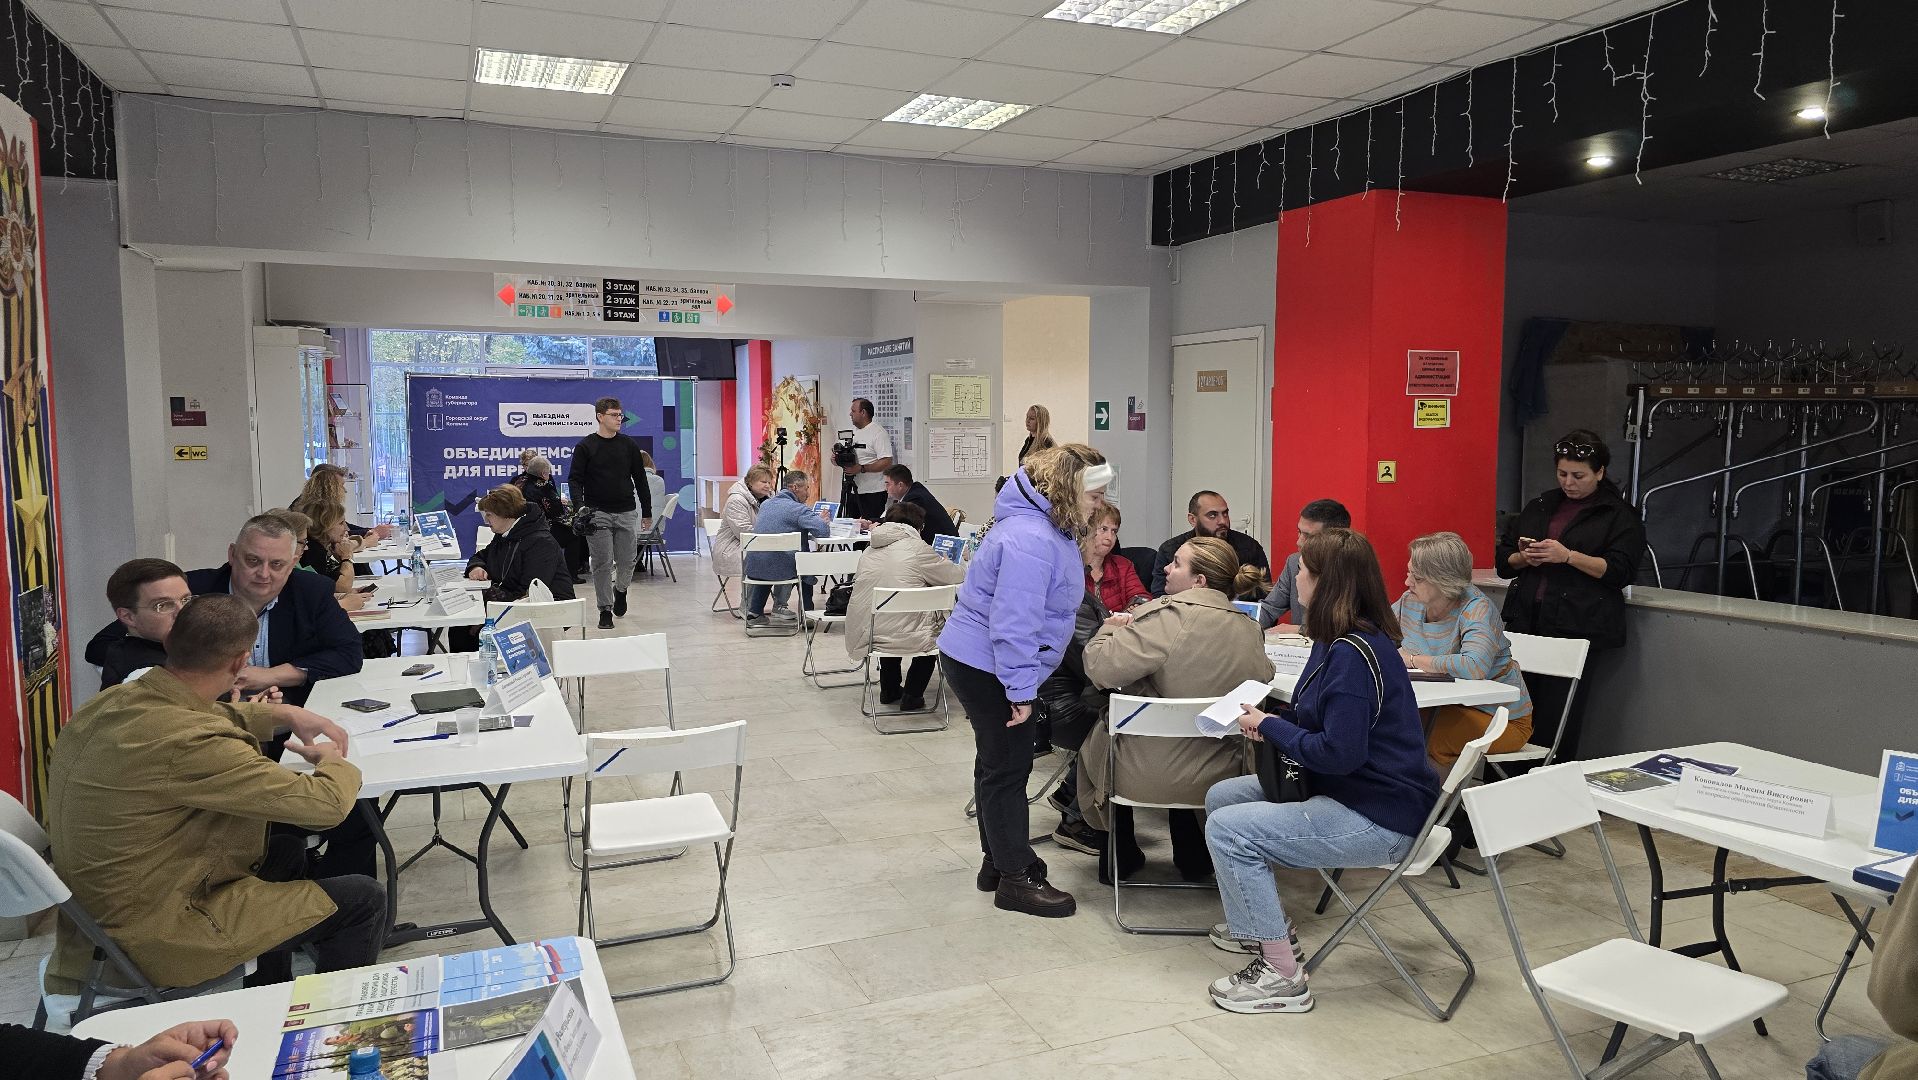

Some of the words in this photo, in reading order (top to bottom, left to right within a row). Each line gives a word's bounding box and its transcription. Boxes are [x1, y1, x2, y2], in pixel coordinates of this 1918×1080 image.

[606, 281, 611, 290] 3
[613, 283, 636, 291] ЭТАЖ
[606, 294, 612, 304] 2
[613, 297, 636, 305] ЭТАЖ
[607, 309, 611, 318] 1
[613, 311, 636, 319] ЭТАЖ
[443, 446, 576, 461] ОБЪЕДИНЕМС
[443, 465, 481, 479] ДЛЯ
[1734, 783, 1765, 795] Максим
[1766, 789, 1815, 805] Викторович
